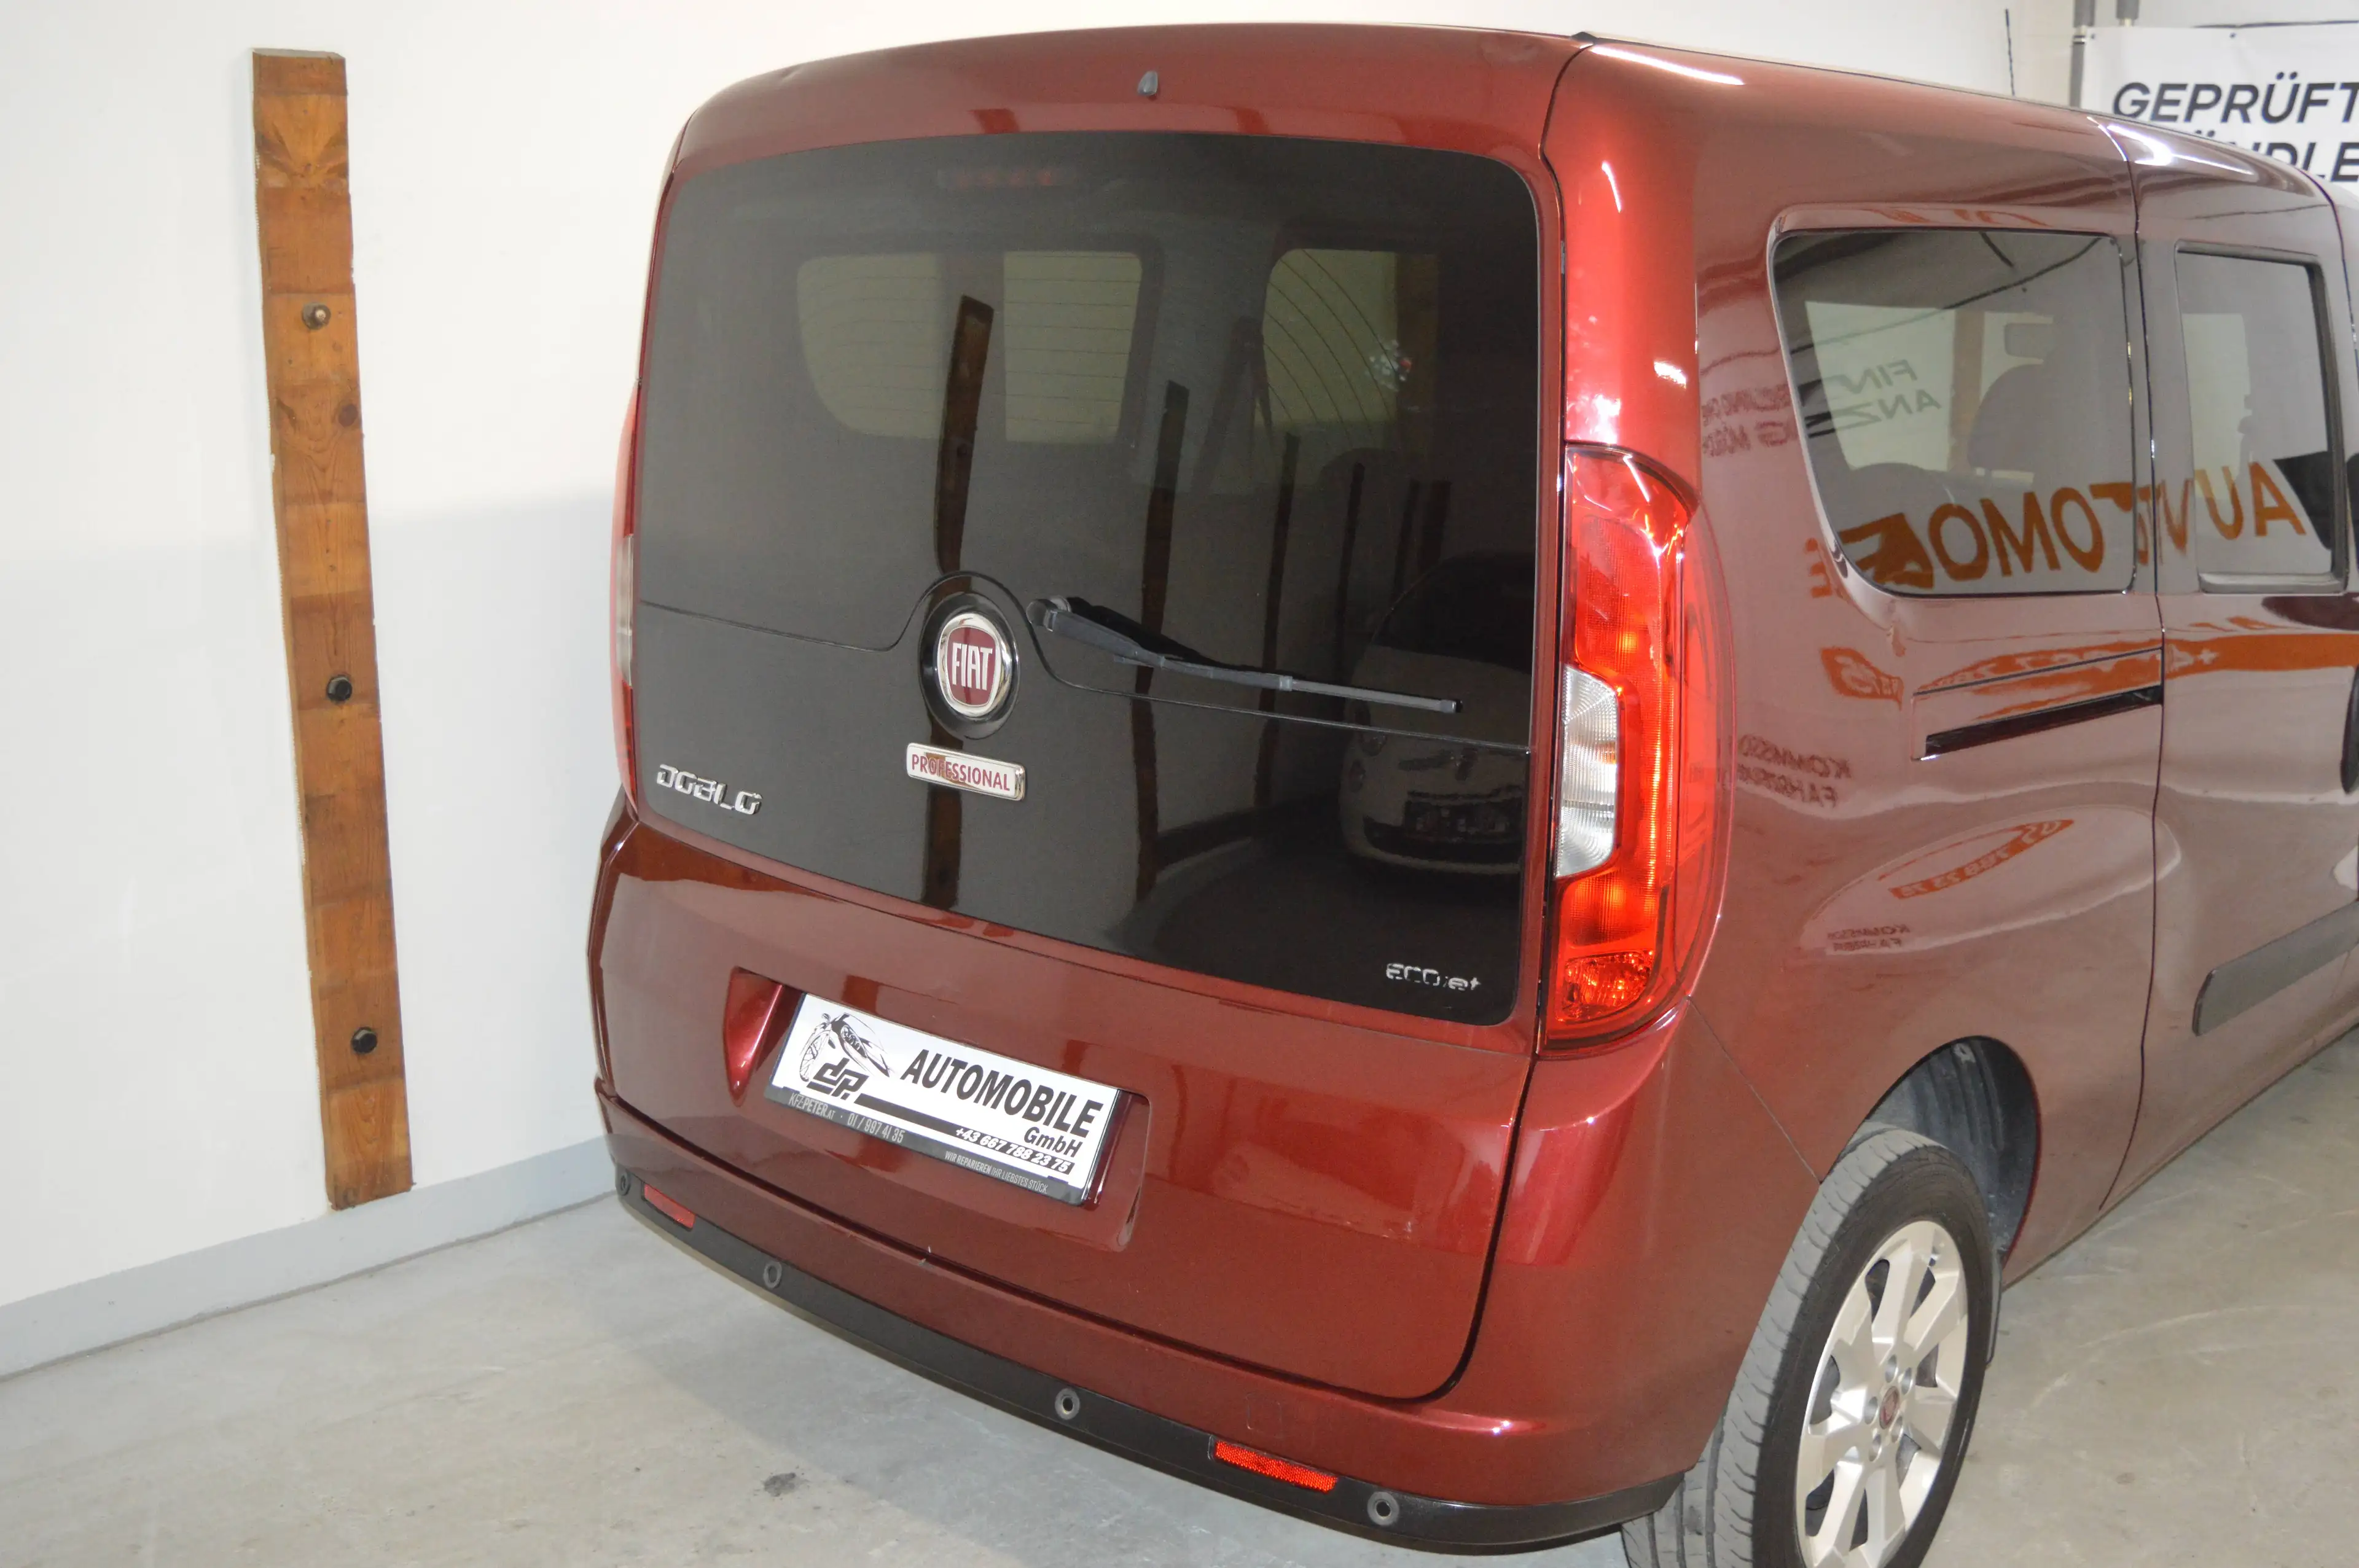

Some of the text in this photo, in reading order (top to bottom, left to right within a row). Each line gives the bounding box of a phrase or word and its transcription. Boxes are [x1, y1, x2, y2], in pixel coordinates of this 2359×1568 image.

[2112, 71, 2359, 123] GEPRÜFT
[952, 642, 993, 691] FIAT
[911, 753, 1011, 792] PROFESSIONAL
[900, 1048, 1105, 1138] AUTOMOBILE
[864, 1118, 883, 1136] 997
[882, 1125, 893, 1139] 41
[891, 1128, 906, 1144] 35
[955, 1127, 1072, 1173] +43 667 788 23 75
[1023, 1126, 1084, 1158] GmbH
[944, 1150, 958, 1163] WIR
[956, 1153, 993, 1174] REPARIEREN
[991, 1166, 1003, 1179] IHR
[1001, 1169, 1030, 1188] LIEBSTES
